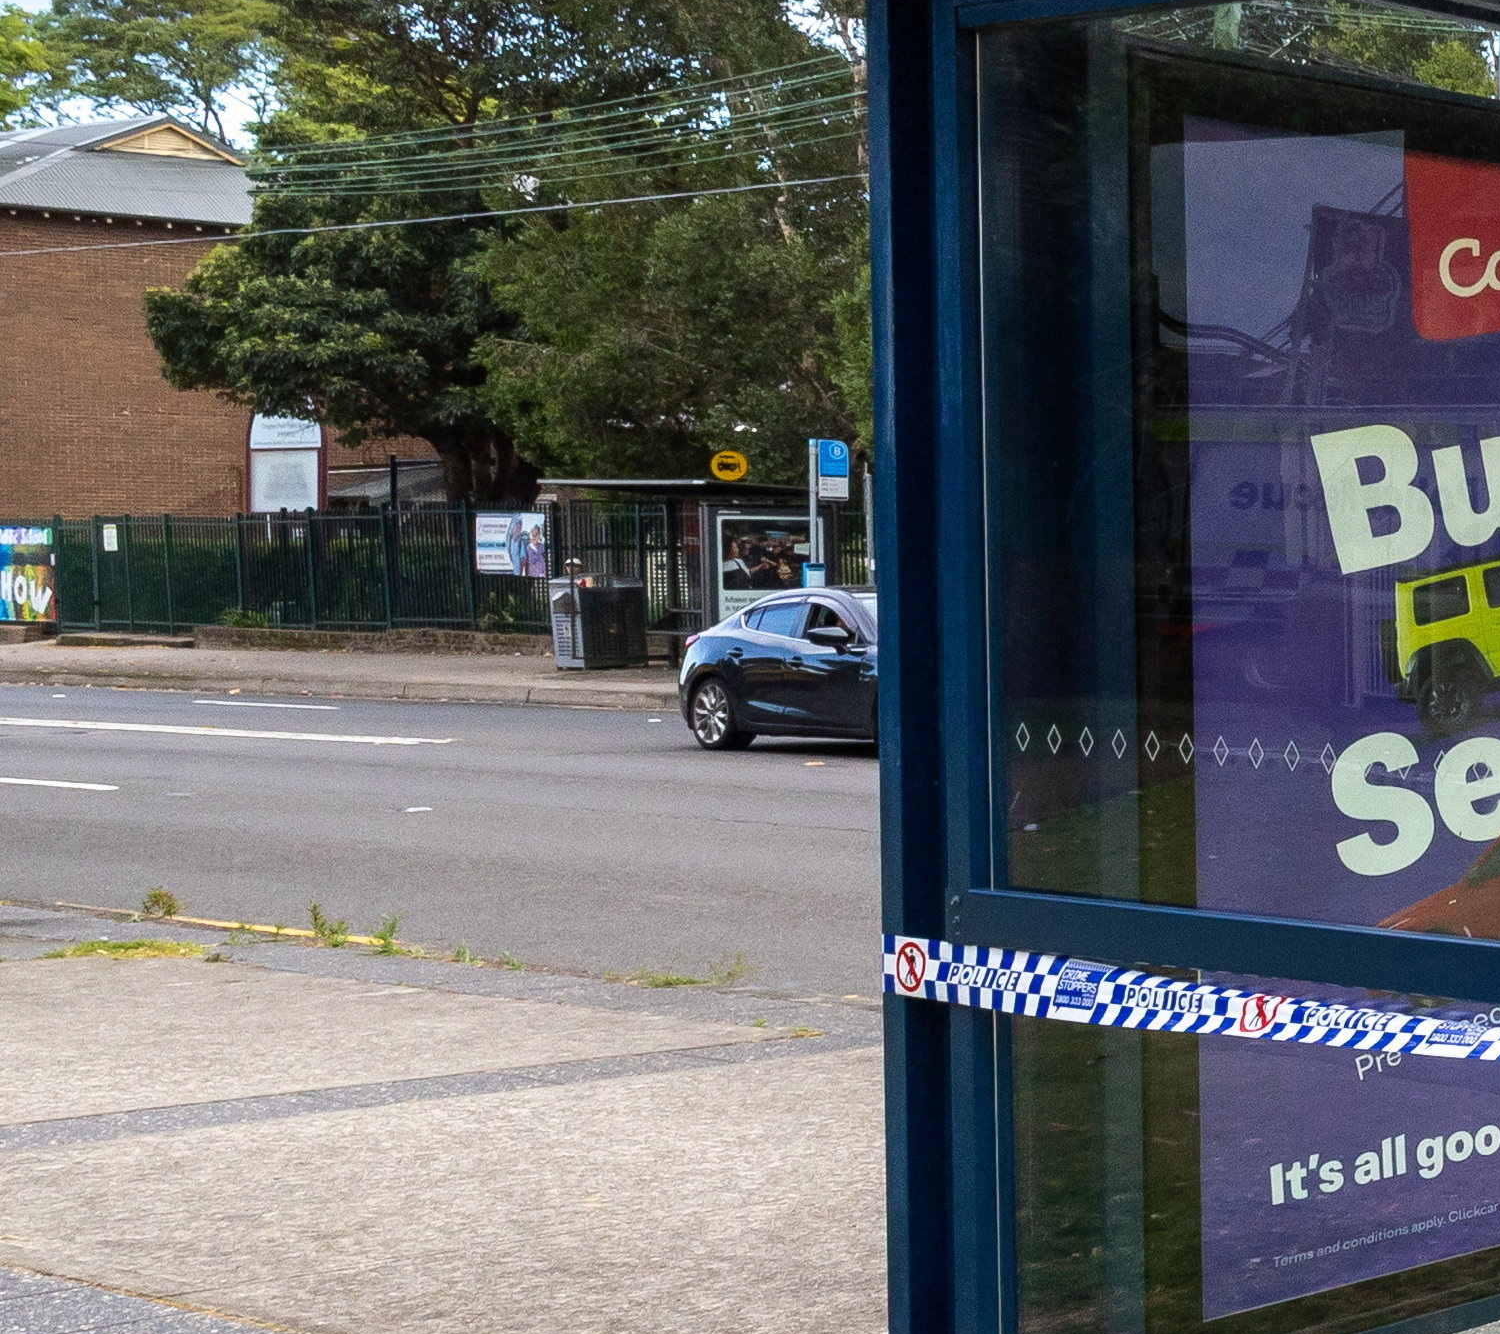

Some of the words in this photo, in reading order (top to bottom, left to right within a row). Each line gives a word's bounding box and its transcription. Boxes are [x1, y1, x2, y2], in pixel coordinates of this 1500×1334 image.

[949, 966, 1019, 991] POLICE
[1058, 979, 1097, 994] STOPPERS
[1061, 968, 1090, 981] CRIME
[1123, 985, 1200, 1013] POLICE
[1269, 1153, 1345, 1206] It's
[1354, 1133, 1407, 1189] all
[1273, 1248, 1314, 1268] Terms
[1316, 1243, 1340, 1259] and
[1342, 1226, 1409, 1253] conditions
[1410, 1215, 1446, 1237] apply.
[1447, 1201, 1498, 1223] Clickcar
